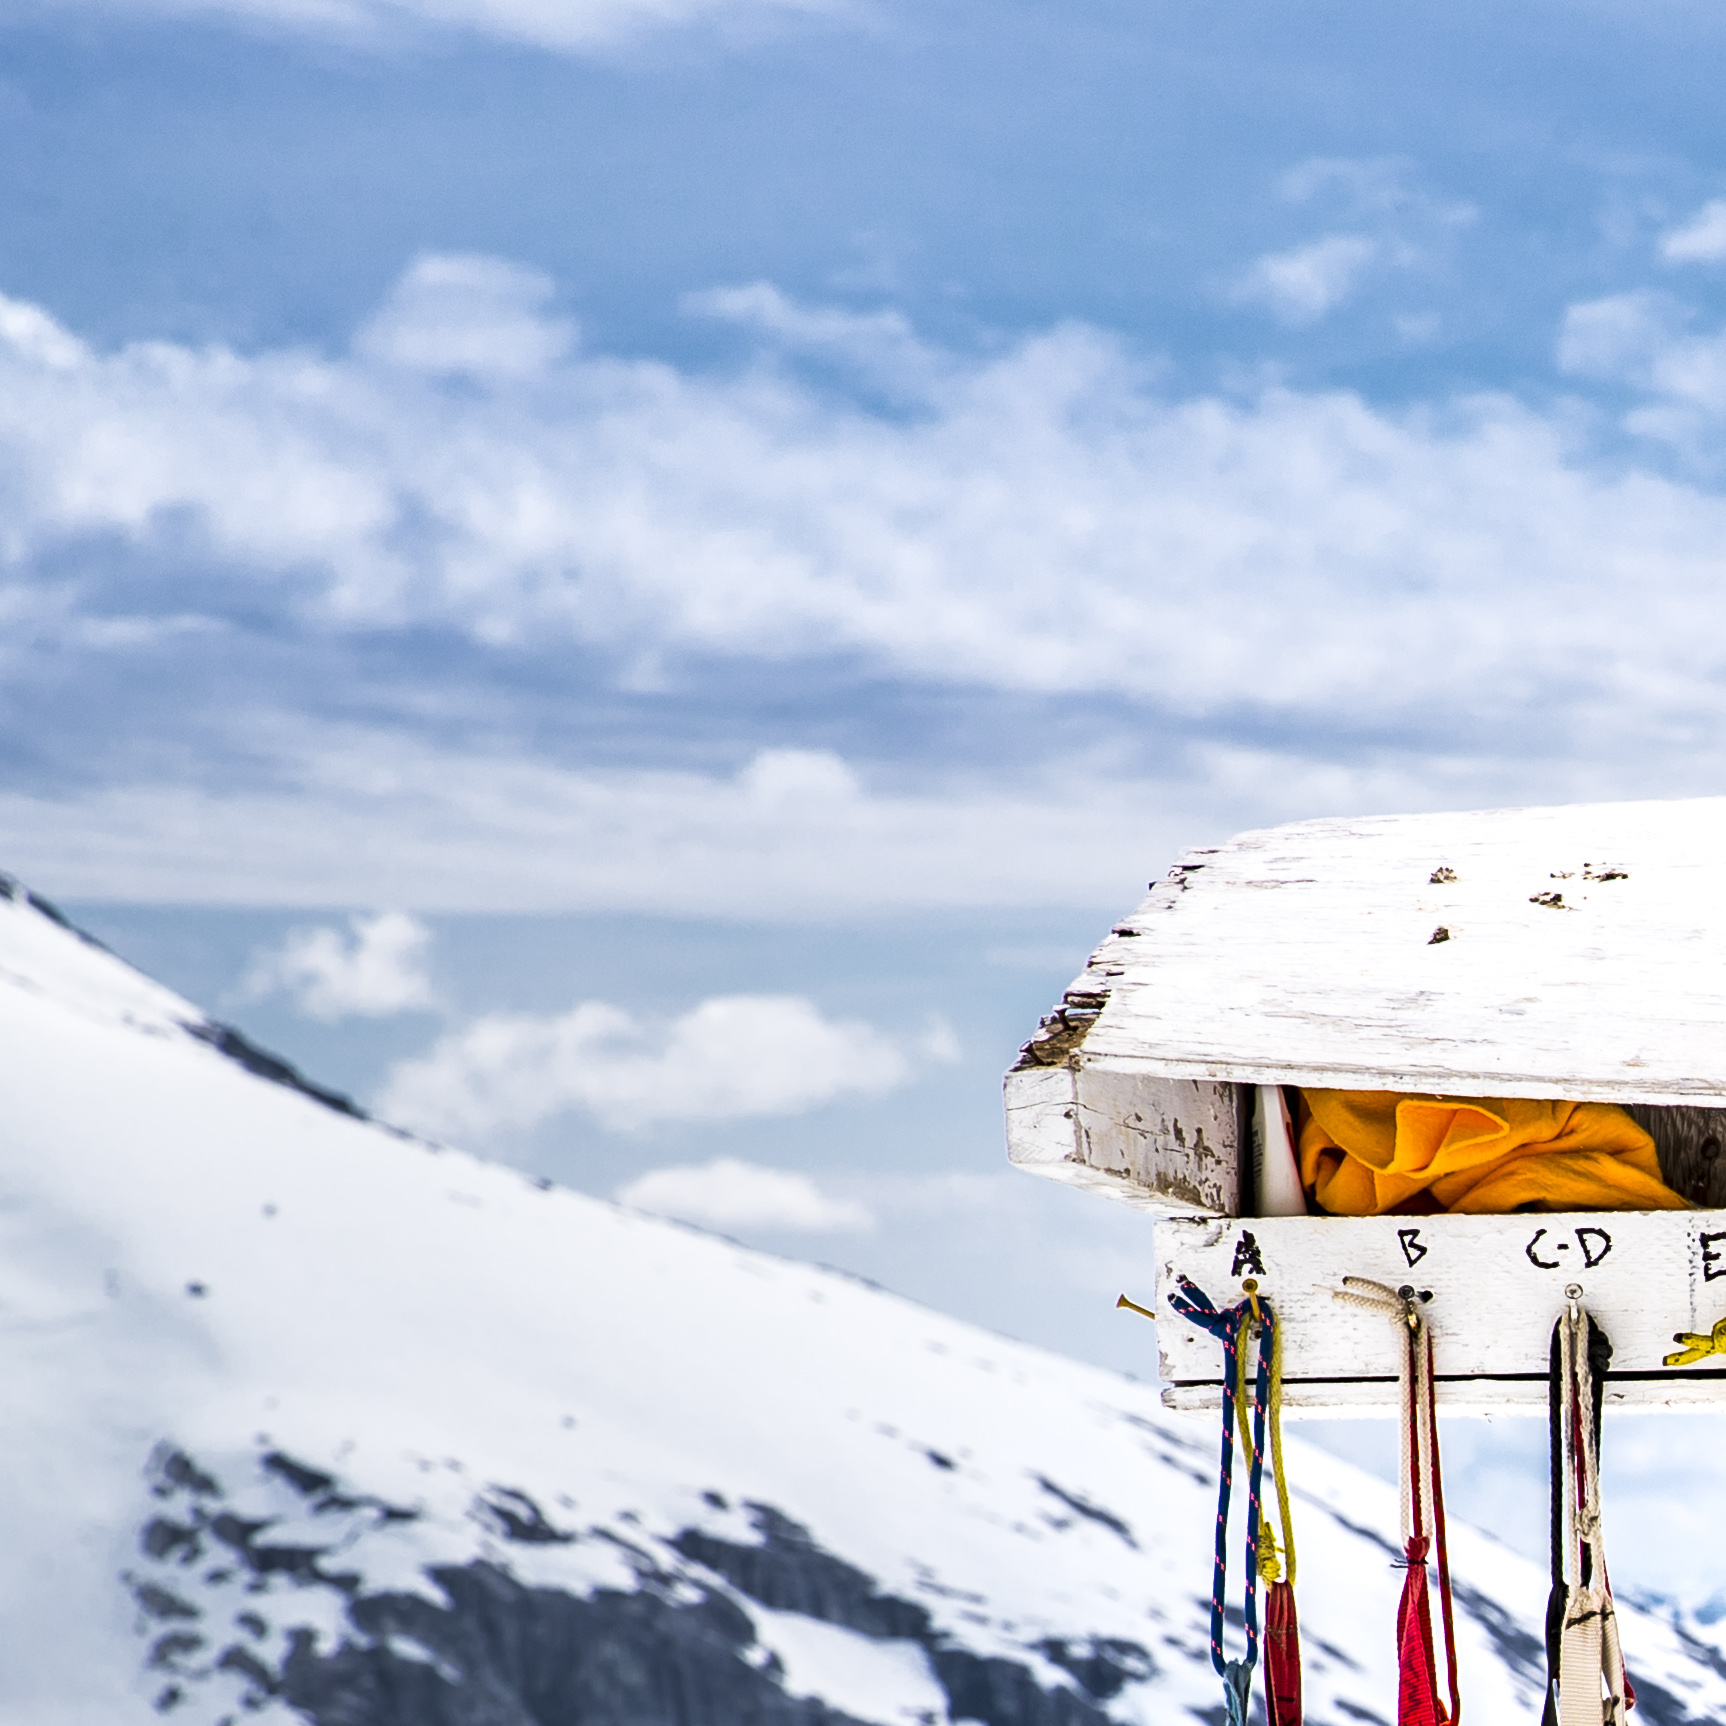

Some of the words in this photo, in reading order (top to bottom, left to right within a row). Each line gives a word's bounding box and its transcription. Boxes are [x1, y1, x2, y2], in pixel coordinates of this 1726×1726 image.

[1230, 1230, 1265, 1276] A
[1397, 1228, 1428, 1268] B
[1525, 1228, 1612, 1268] C-D
